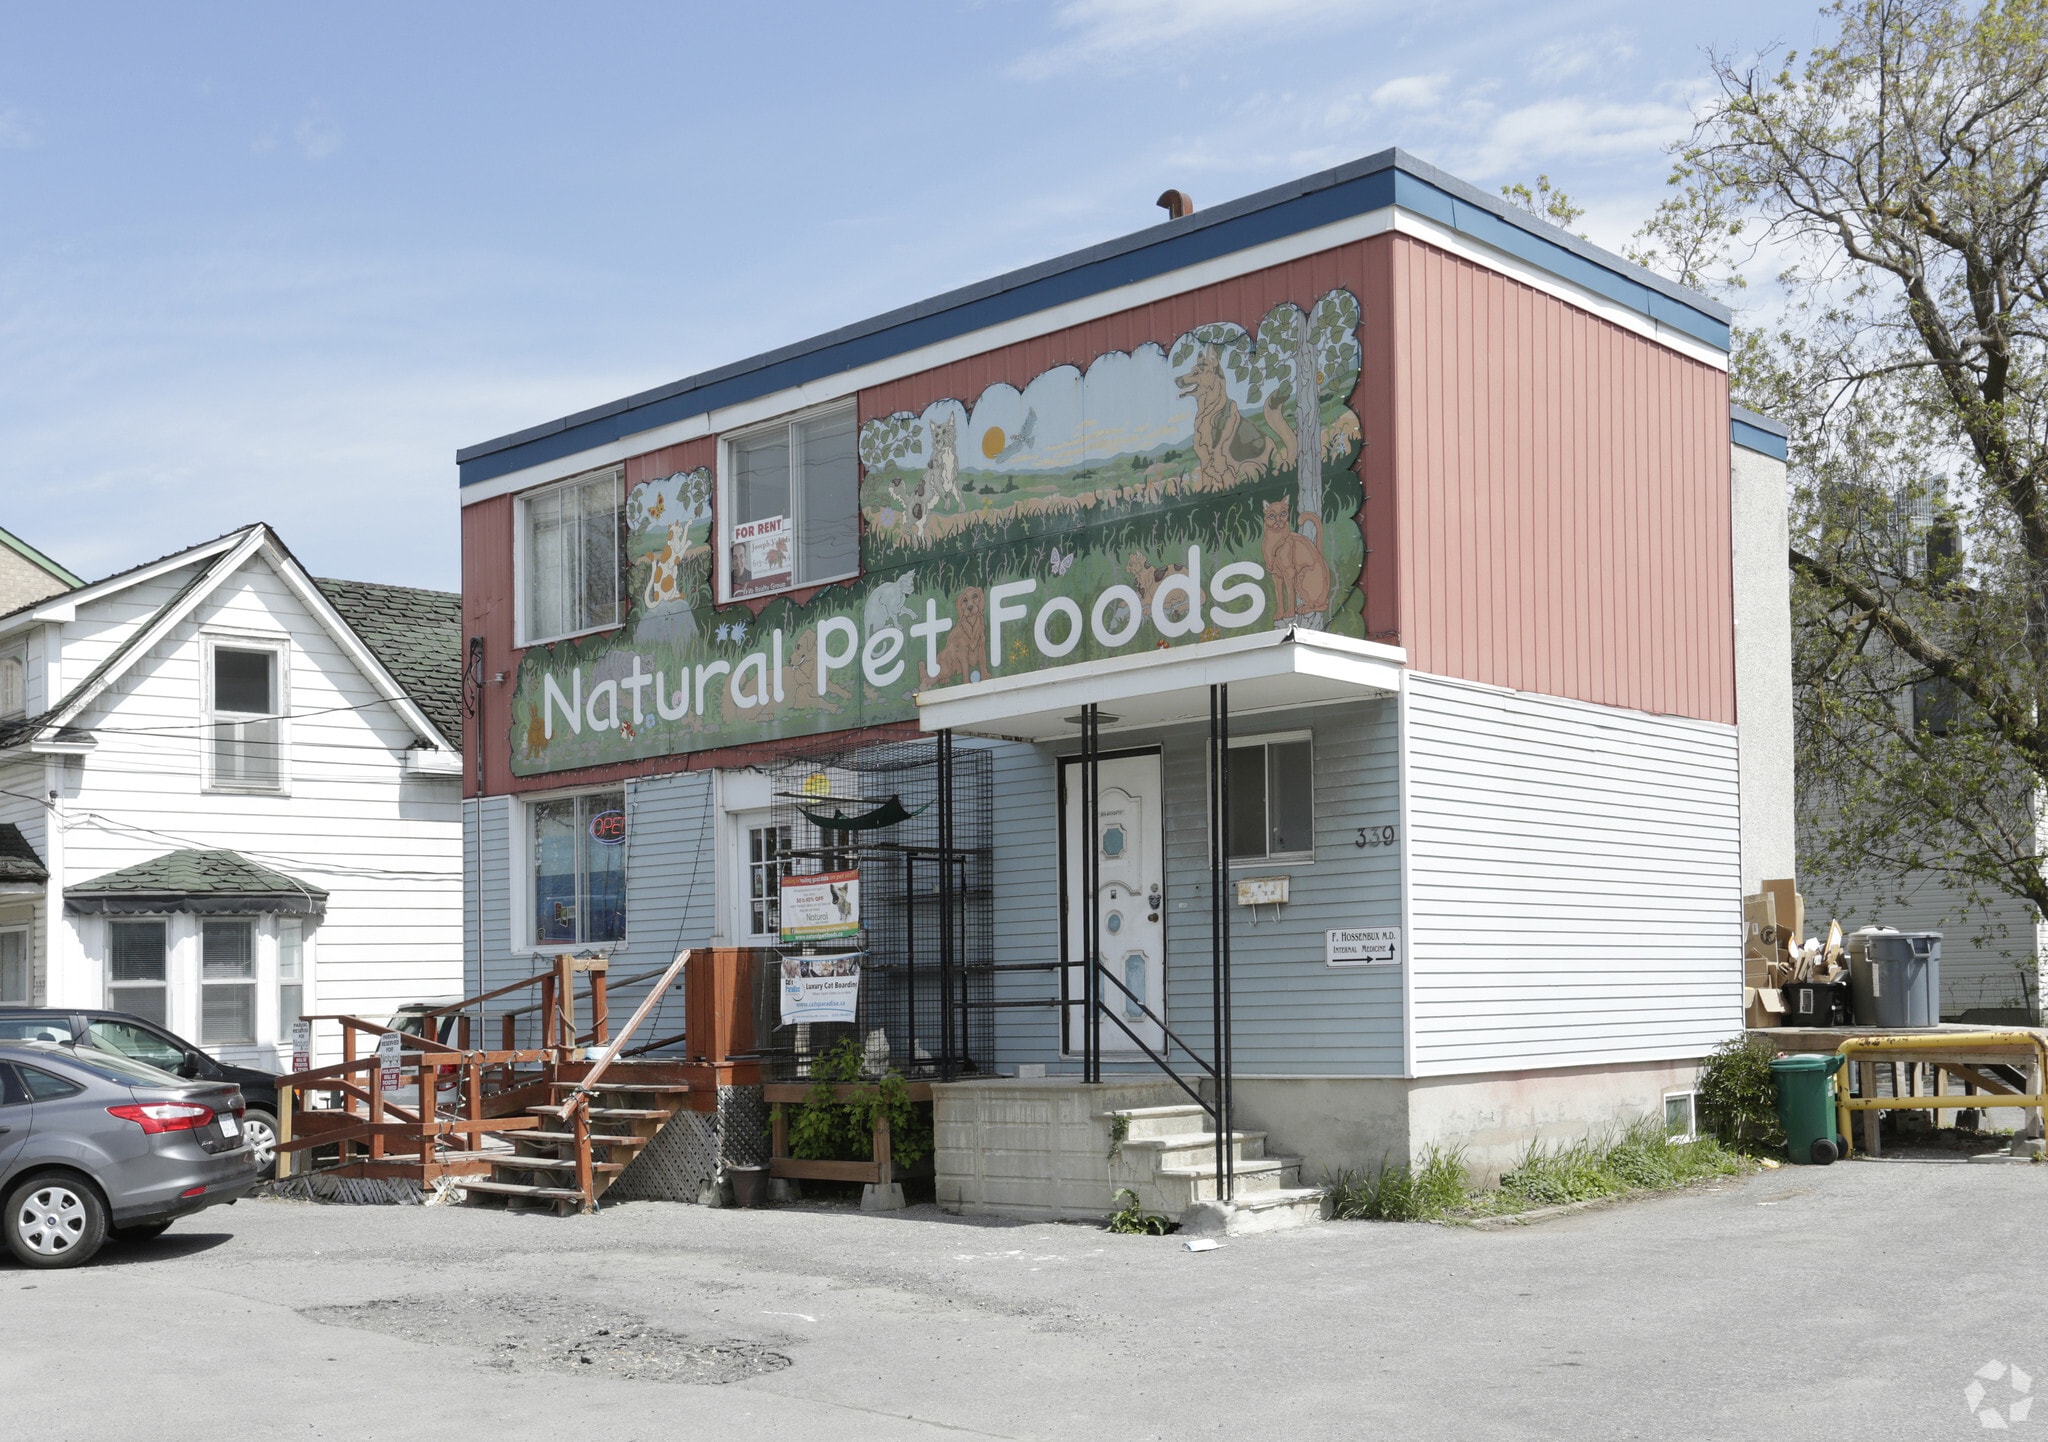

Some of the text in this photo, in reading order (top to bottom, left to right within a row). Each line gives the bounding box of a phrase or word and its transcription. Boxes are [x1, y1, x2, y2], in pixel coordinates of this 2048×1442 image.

[736, 519, 782, 540] FOR RENT
[544, 545, 1266, 740] Natural Pet Foods
[1355, 825, 1395, 848] 339
[1382, 931, 1396, 941] M.D.
